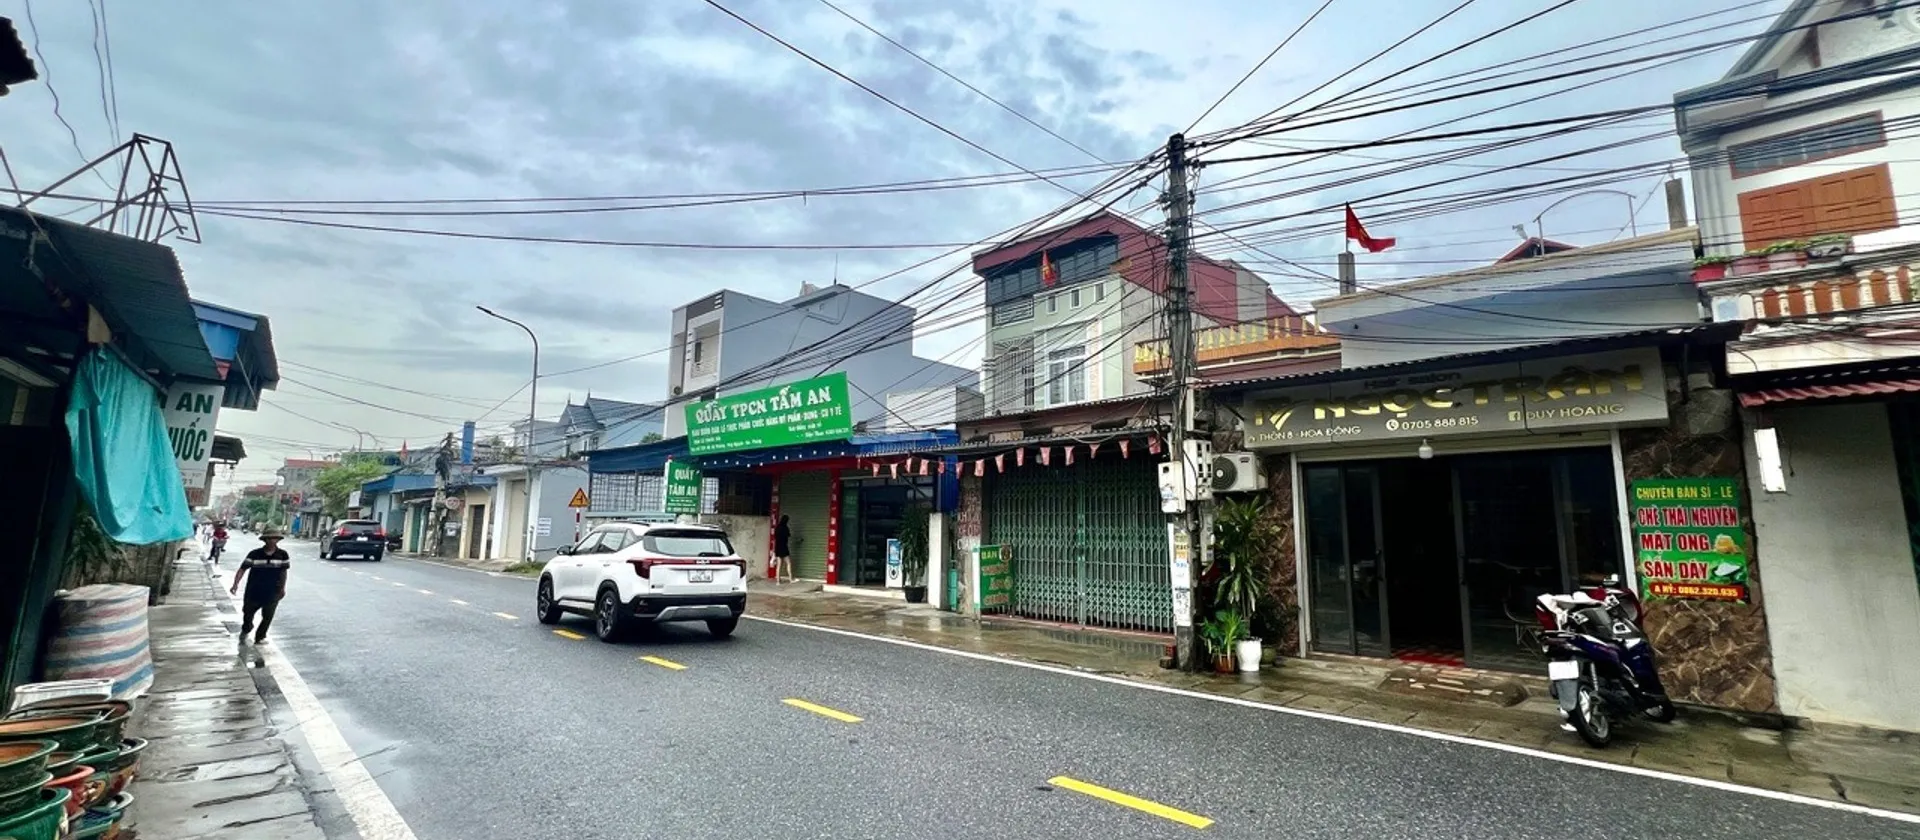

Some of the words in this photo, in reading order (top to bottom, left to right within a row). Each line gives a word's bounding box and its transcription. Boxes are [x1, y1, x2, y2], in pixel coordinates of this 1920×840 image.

[175, 391, 214, 414] AN
[731, 399, 768, 418] TPCN
[807, 386, 832, 405] AN
[1313, 386, 1454, 420] NGỌC
[1402, 419, 1432, 431] 0705
[1434, 418, 1457, 428] 888
[1459, 416, 1479, 426] 815
[1527, 409, 1556, 420] DUY
[1637, 504, 1660, 527] CHÈ
[1662, 504, 1689, 527] THÁI
[1691, 505, 1738, 526] NGUYÊN
[1639, 531, 1672, 553] MẬT
[1676, 533, 1710, 552] ONG
[1678, 557, 1709, 580] DÂY
